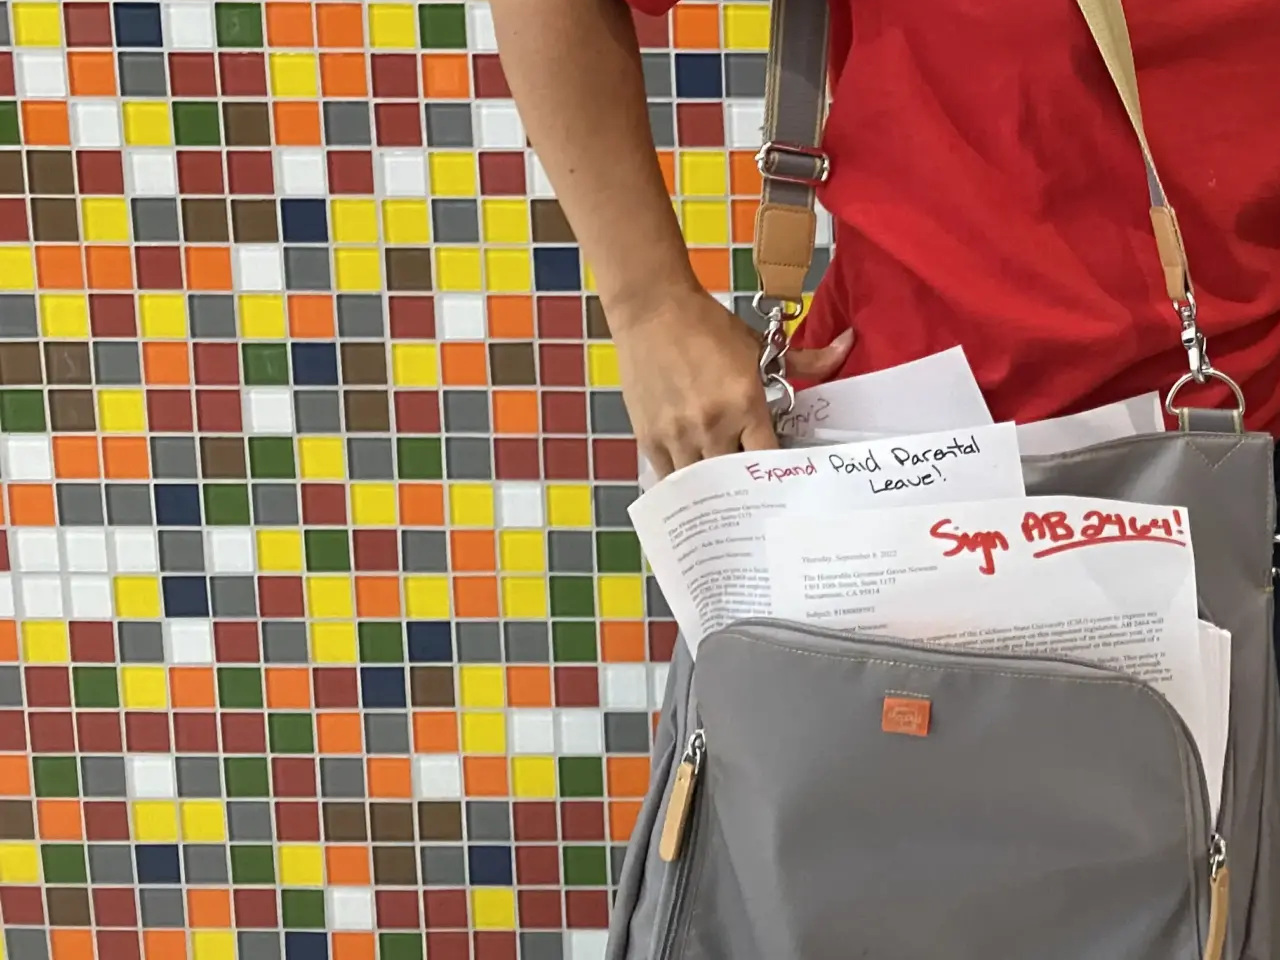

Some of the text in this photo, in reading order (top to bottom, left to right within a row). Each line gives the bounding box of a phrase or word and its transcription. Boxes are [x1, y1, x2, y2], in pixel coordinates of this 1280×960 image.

[745, 435, 981, 483] Expand Paid Parental
[869, 465, 947, 494] Leave!
[835, 553, 871, 562] September
[929, 509, 1185, 575] Sign AB 2464!
